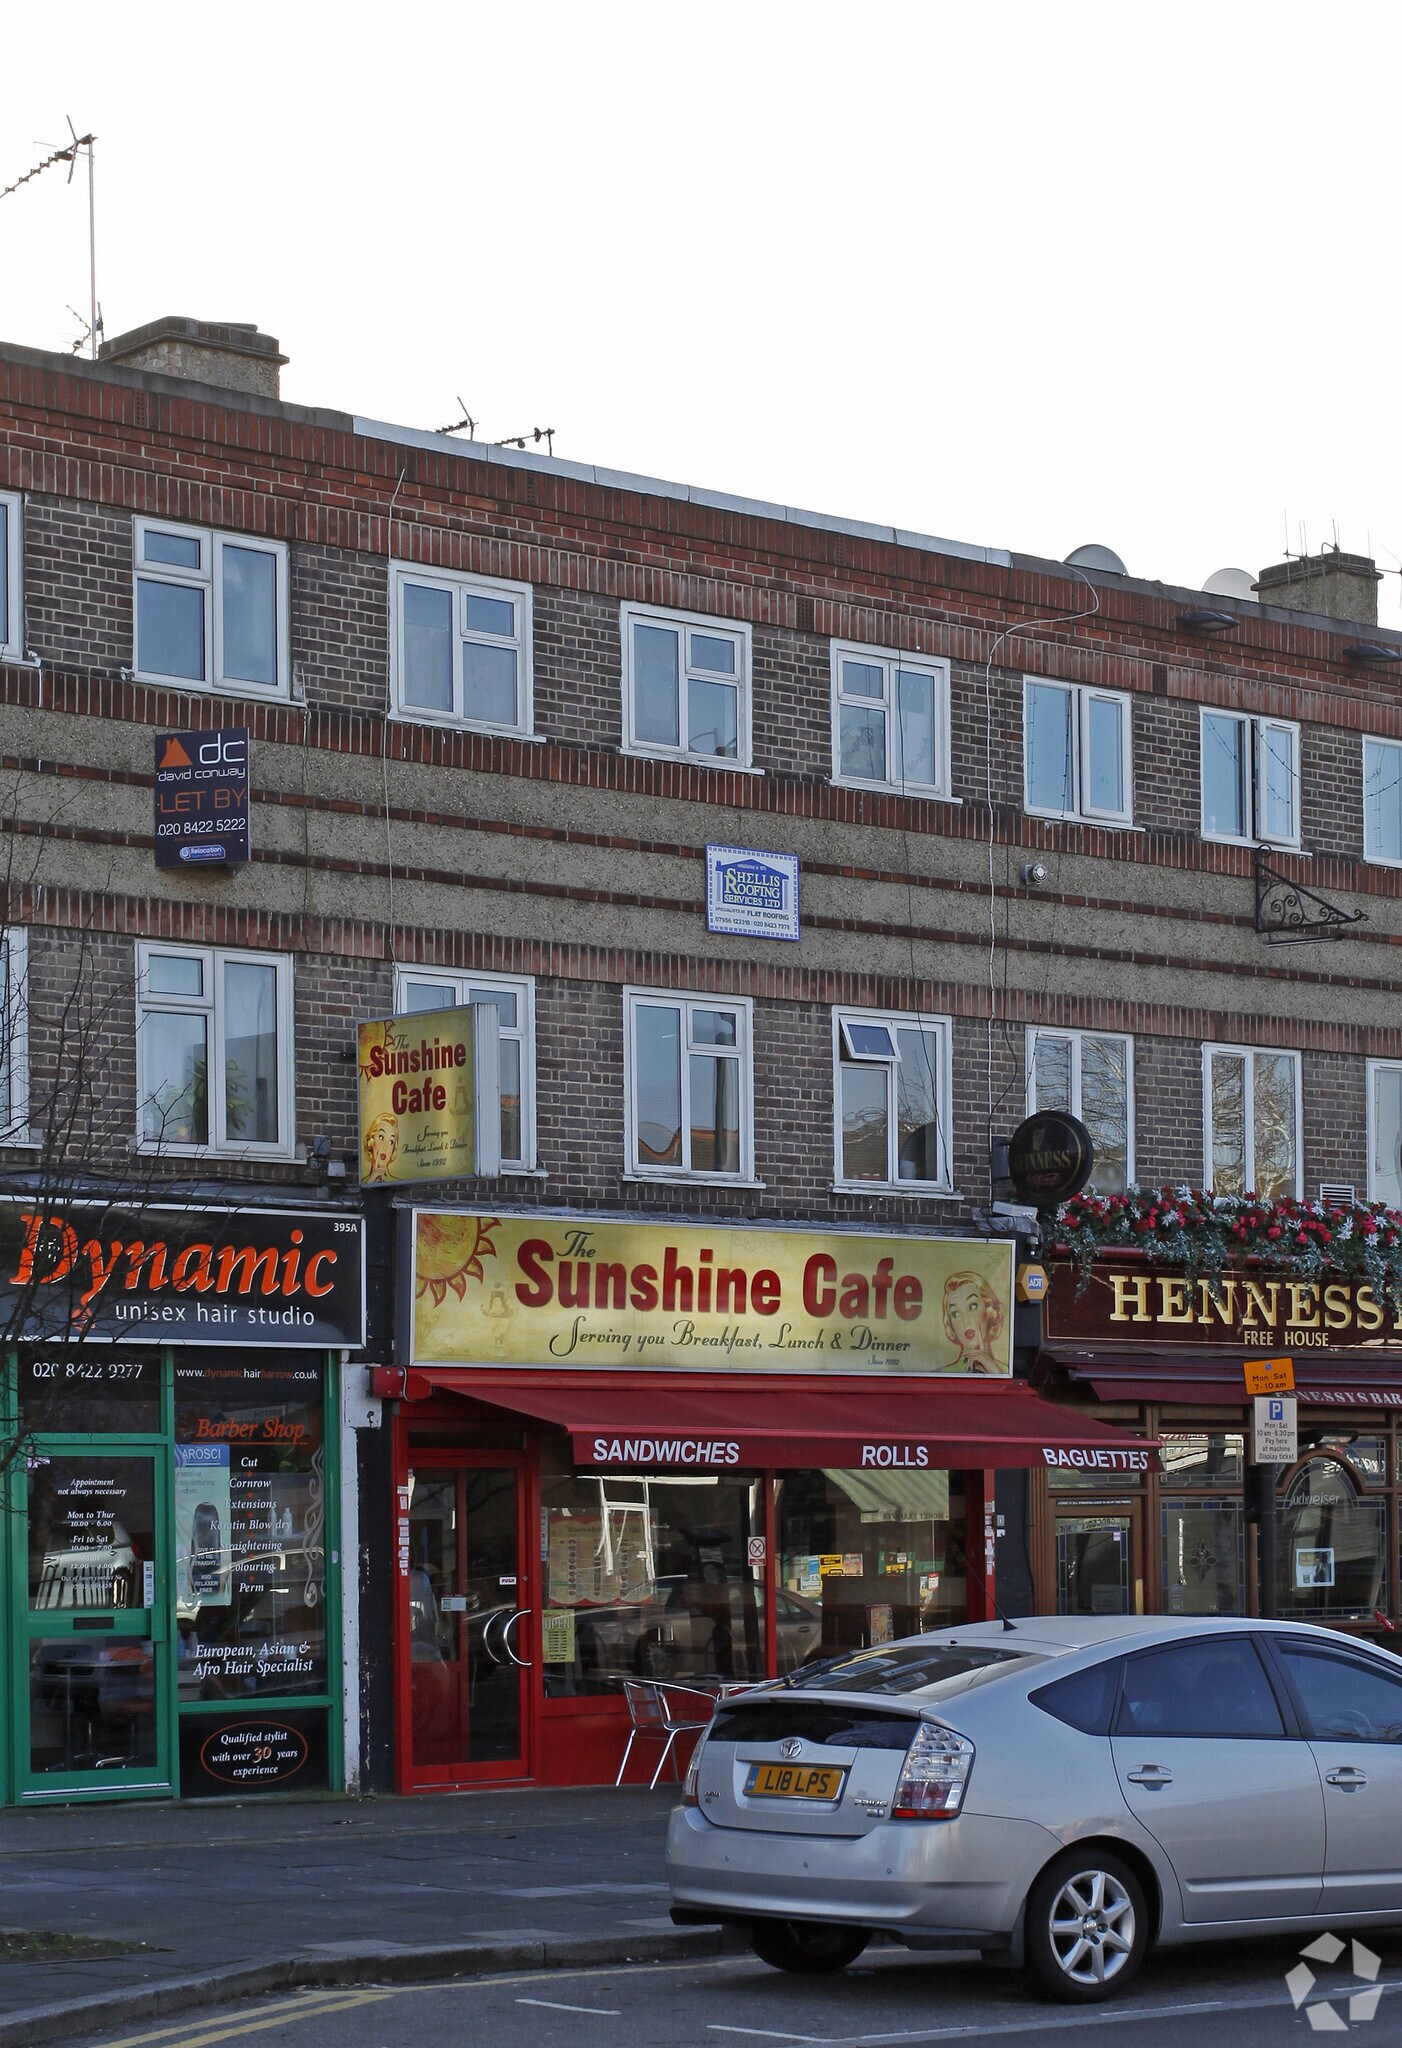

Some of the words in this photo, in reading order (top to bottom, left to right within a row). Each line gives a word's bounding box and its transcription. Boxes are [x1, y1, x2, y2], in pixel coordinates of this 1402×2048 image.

[200, 733, 245, 764] dc
[158, 769, 192, 782] david
[195, 767, 245, 779] conway
[160, 790, 207, 813] LET
[214, 787, 246, 809] BY
[158, 823, 181, 836] 020
[184, 821, 213, 834] 8422
[216, 818, 246, 832] 5222
[724, 876, 780, 899] ROOFING
[724, 894, 762, 906] SERVICES
[765, 899, 780, 908] LTD
[763, 912, 789, 920] ROOFING
[393, 1034, 409, 1051] The
[370, 1038, 466, 1078] Sunshine
[392, 1077, 446, 1116] Cafe
[417, 1125, 440, 1142] Serving
[1014, 1150, 1072, 1170] INNESS
[333, 1222, 358, 1233] 395A
[556, 1230, 597, 1259] The
[9, 1213, 338, 1332] Dynamic
[515, 1239, 782, 1317] Sunshine
[802, 1252, 924, 1322] Cafe
[115, 1302, 186, 1322] unisex
[197, 1302, 238, 1324] hair
[248, 1306, 315, 1326] studio
[549, 1316, 632, 1357] Serving
[637, 1336, 666, 1352] you
[670, 1319, 763, 1354] Breakfast,
[768, 1322, 824, 1350] Lunch
[830, 1332, 842, 1350] &
[850, 1324, 911, 1352] Dinner
[1243, 1331, 1274, 1346] FREE
[1284, 1330, 1329, 1348] HOUSE
[108, 1363, 143, 1380] 9277
[176, 1367, 318, 1380] www.dynamichairharrow.co.uk
[1265, 1382, 1274, 1390] 10
[1272, 1402, 1281, 1419] P
[196, 1416, 258, 1438] Barber
[263, 1416, 305, 1444] Shop
[241, 1457, 258, 1468] Cut
[593, 1439, 740, 1464] SANDWICHES
[862, 1445, 929, 1467] ROLLS
[1042, 1448, 1150, 1470] BAGUETTES
[1259, 1453, 1278, 1461] Display
[70, 1478, 114, 1488] Appointment
[229, 1478, 272, 1488] Cornrow
[70, 1488, 93, 1497] always
[1289, 1492, 1340, 1505] udweiser
[224, 1499, 277, 1509] Extensions
[67, 1511, 84, 1519] Mon
[96, 1510, 115, 1519] Thur
[210, 1519, 246, 1530] Keratin
[249, 1520, 272, 1530] Blow
[275, 1519, 292, 1532] dry
[73, 1535, 84, 1543] Fri
[96, 1534, 108, 1543] Sat
[220, 1540, 282, 1554] Straightening
[229, 1562, 276, 1574] Colouring
[239, 1582, 264, 1593] Perm
[195, 1644, 256, 1660] European,
[259, 1642, 294, 1656] Asian
[299, 1640, 311, 1654] &
[193, 1661, 221, 1680] Afro
[224, 1660, 254, 1675] Hair
[256, 1658, 314, 1677] Specialist
[220, 1732, 262, 1745] Qualified
[264, 1731, 288, 1744] stylist
[212, 1752, 230, 1762] with
[232, 1753, 251, 1762] over
[252, 1746, 272, 1764] 30
[277, 1750, 298, 1760] years
[233, 1765, 279, 1778] experience
[764, 1770, 793, 1791] L18
[794, 1771, 831, 1794] LPS
